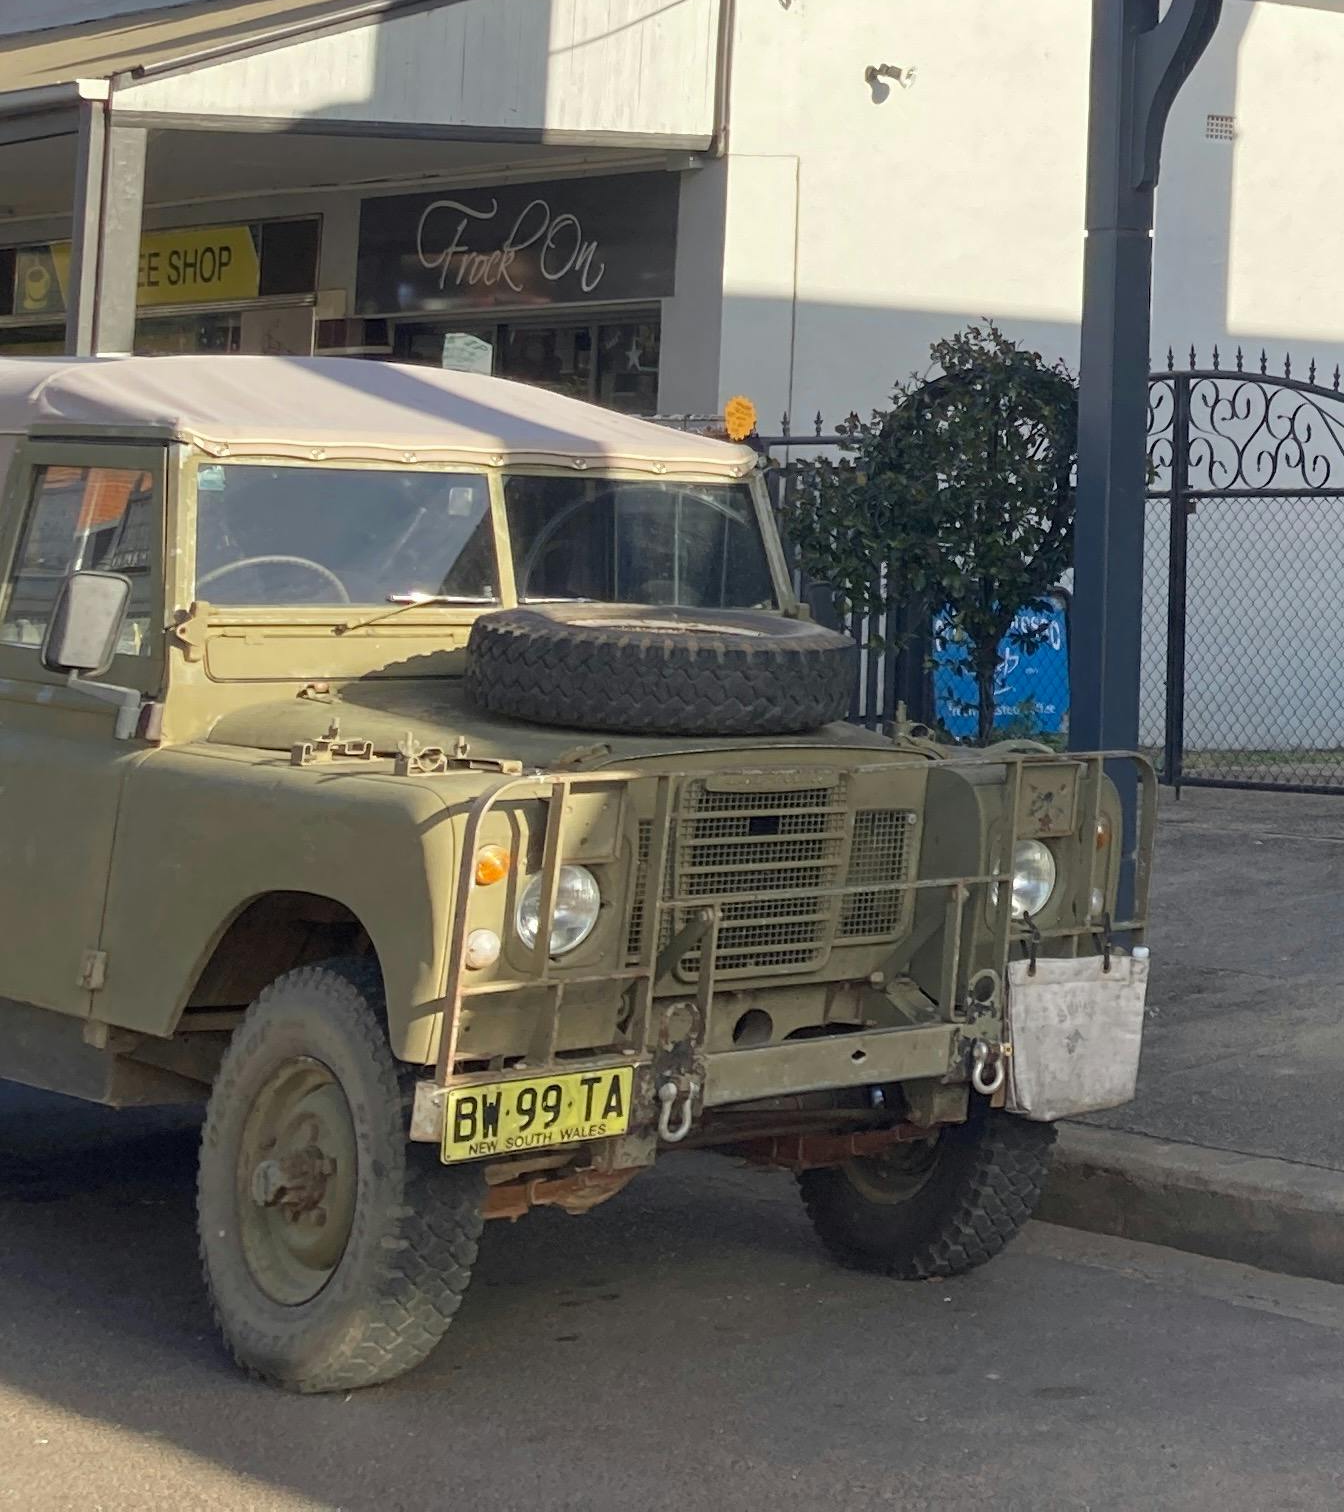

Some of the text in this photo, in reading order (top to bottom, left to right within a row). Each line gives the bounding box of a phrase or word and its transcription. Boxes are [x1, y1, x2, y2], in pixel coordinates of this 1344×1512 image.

[417, 198, 605, 291] Frock On
[167, 245, 232, 286] SHOP
[468, 1124, 607, 1156] NEW SOUTH WALES
